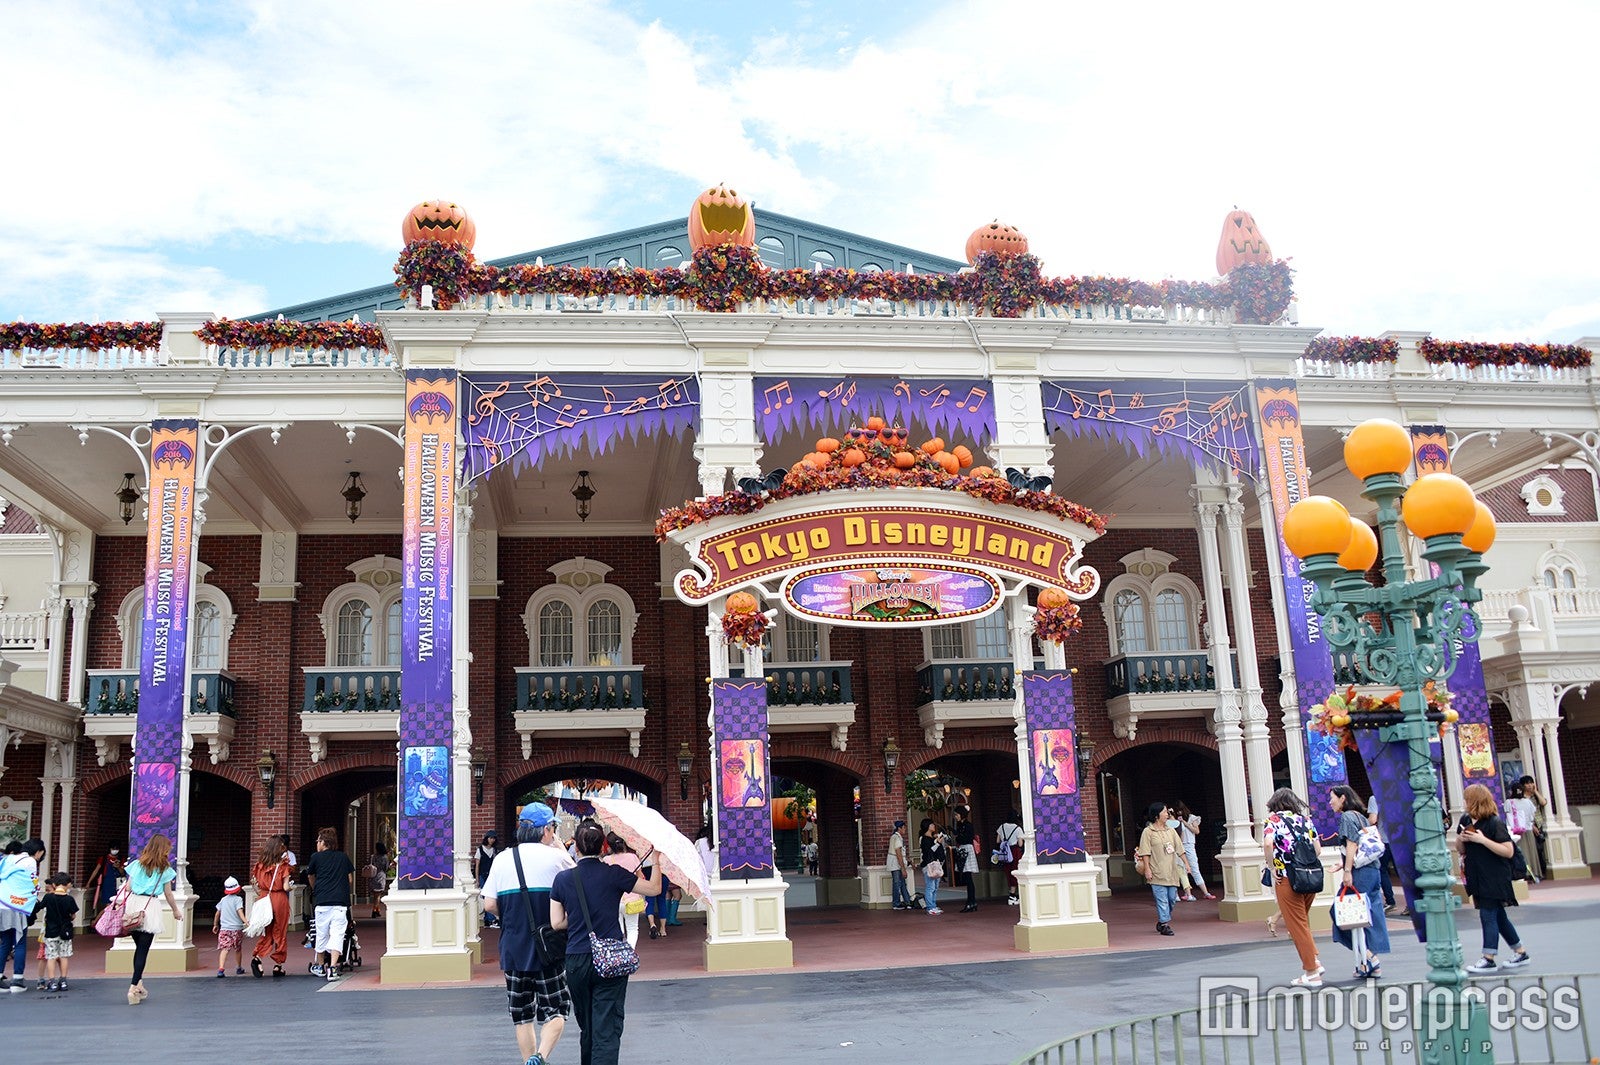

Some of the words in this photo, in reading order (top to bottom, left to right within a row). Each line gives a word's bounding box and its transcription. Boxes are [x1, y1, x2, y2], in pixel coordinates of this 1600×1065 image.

[421, 403, 440, 411] 2016
[163, 450, 181, 458] 2016
[419, 433, 439, 527] HALLOWEEN
[1279, 436, 1300, 508] HALLOWE
[159, 478, 179, 565] HALLOWEEN
[716, 525, 831, 571] Tokyo
[843, 516, 1055, 569] Disneyland
[419, 531, 436, 583] MUSIC
[156, 567, 174, 615] MUSIC
[850, 583, 941, 615] HALLOWEEN
[887, 597, 909, 609] 2016
[418, 586, 435, 662] FESTIVAL
[152, 618, 171, 687] FESTIVAL
